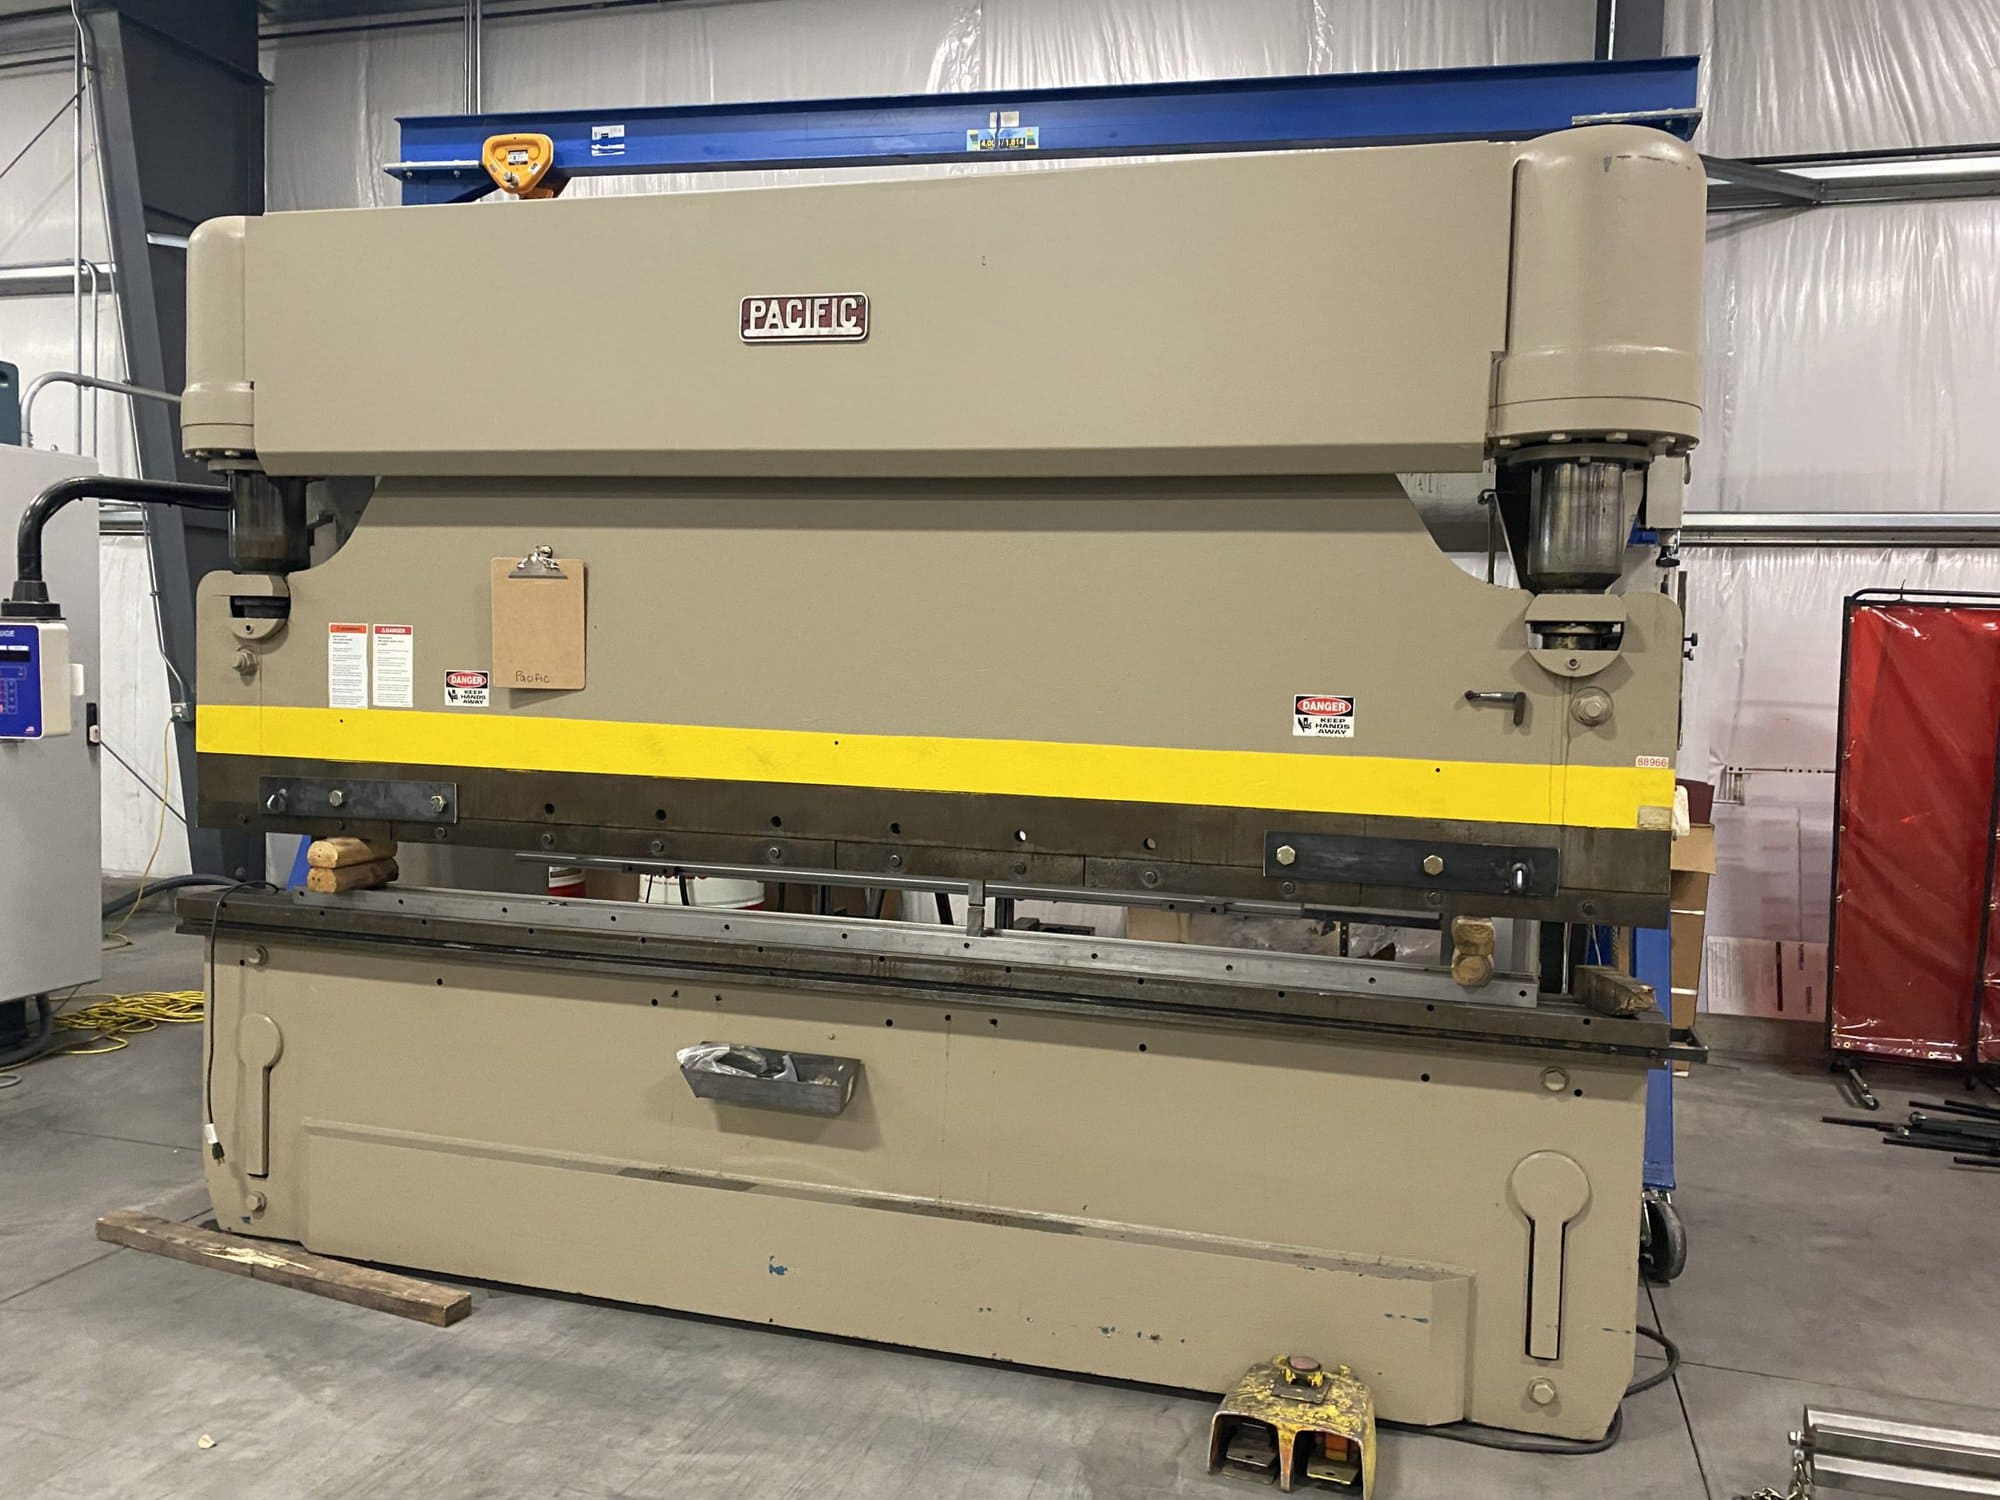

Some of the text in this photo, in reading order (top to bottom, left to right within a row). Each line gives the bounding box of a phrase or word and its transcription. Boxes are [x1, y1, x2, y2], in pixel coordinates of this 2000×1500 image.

[749, 297, 857, 330] PACIFIC
[450, 675, 483, 685] DANGER
[1302, 700, 1346, 712] DANGER
[1637, 757, 1667, 767] 88966
